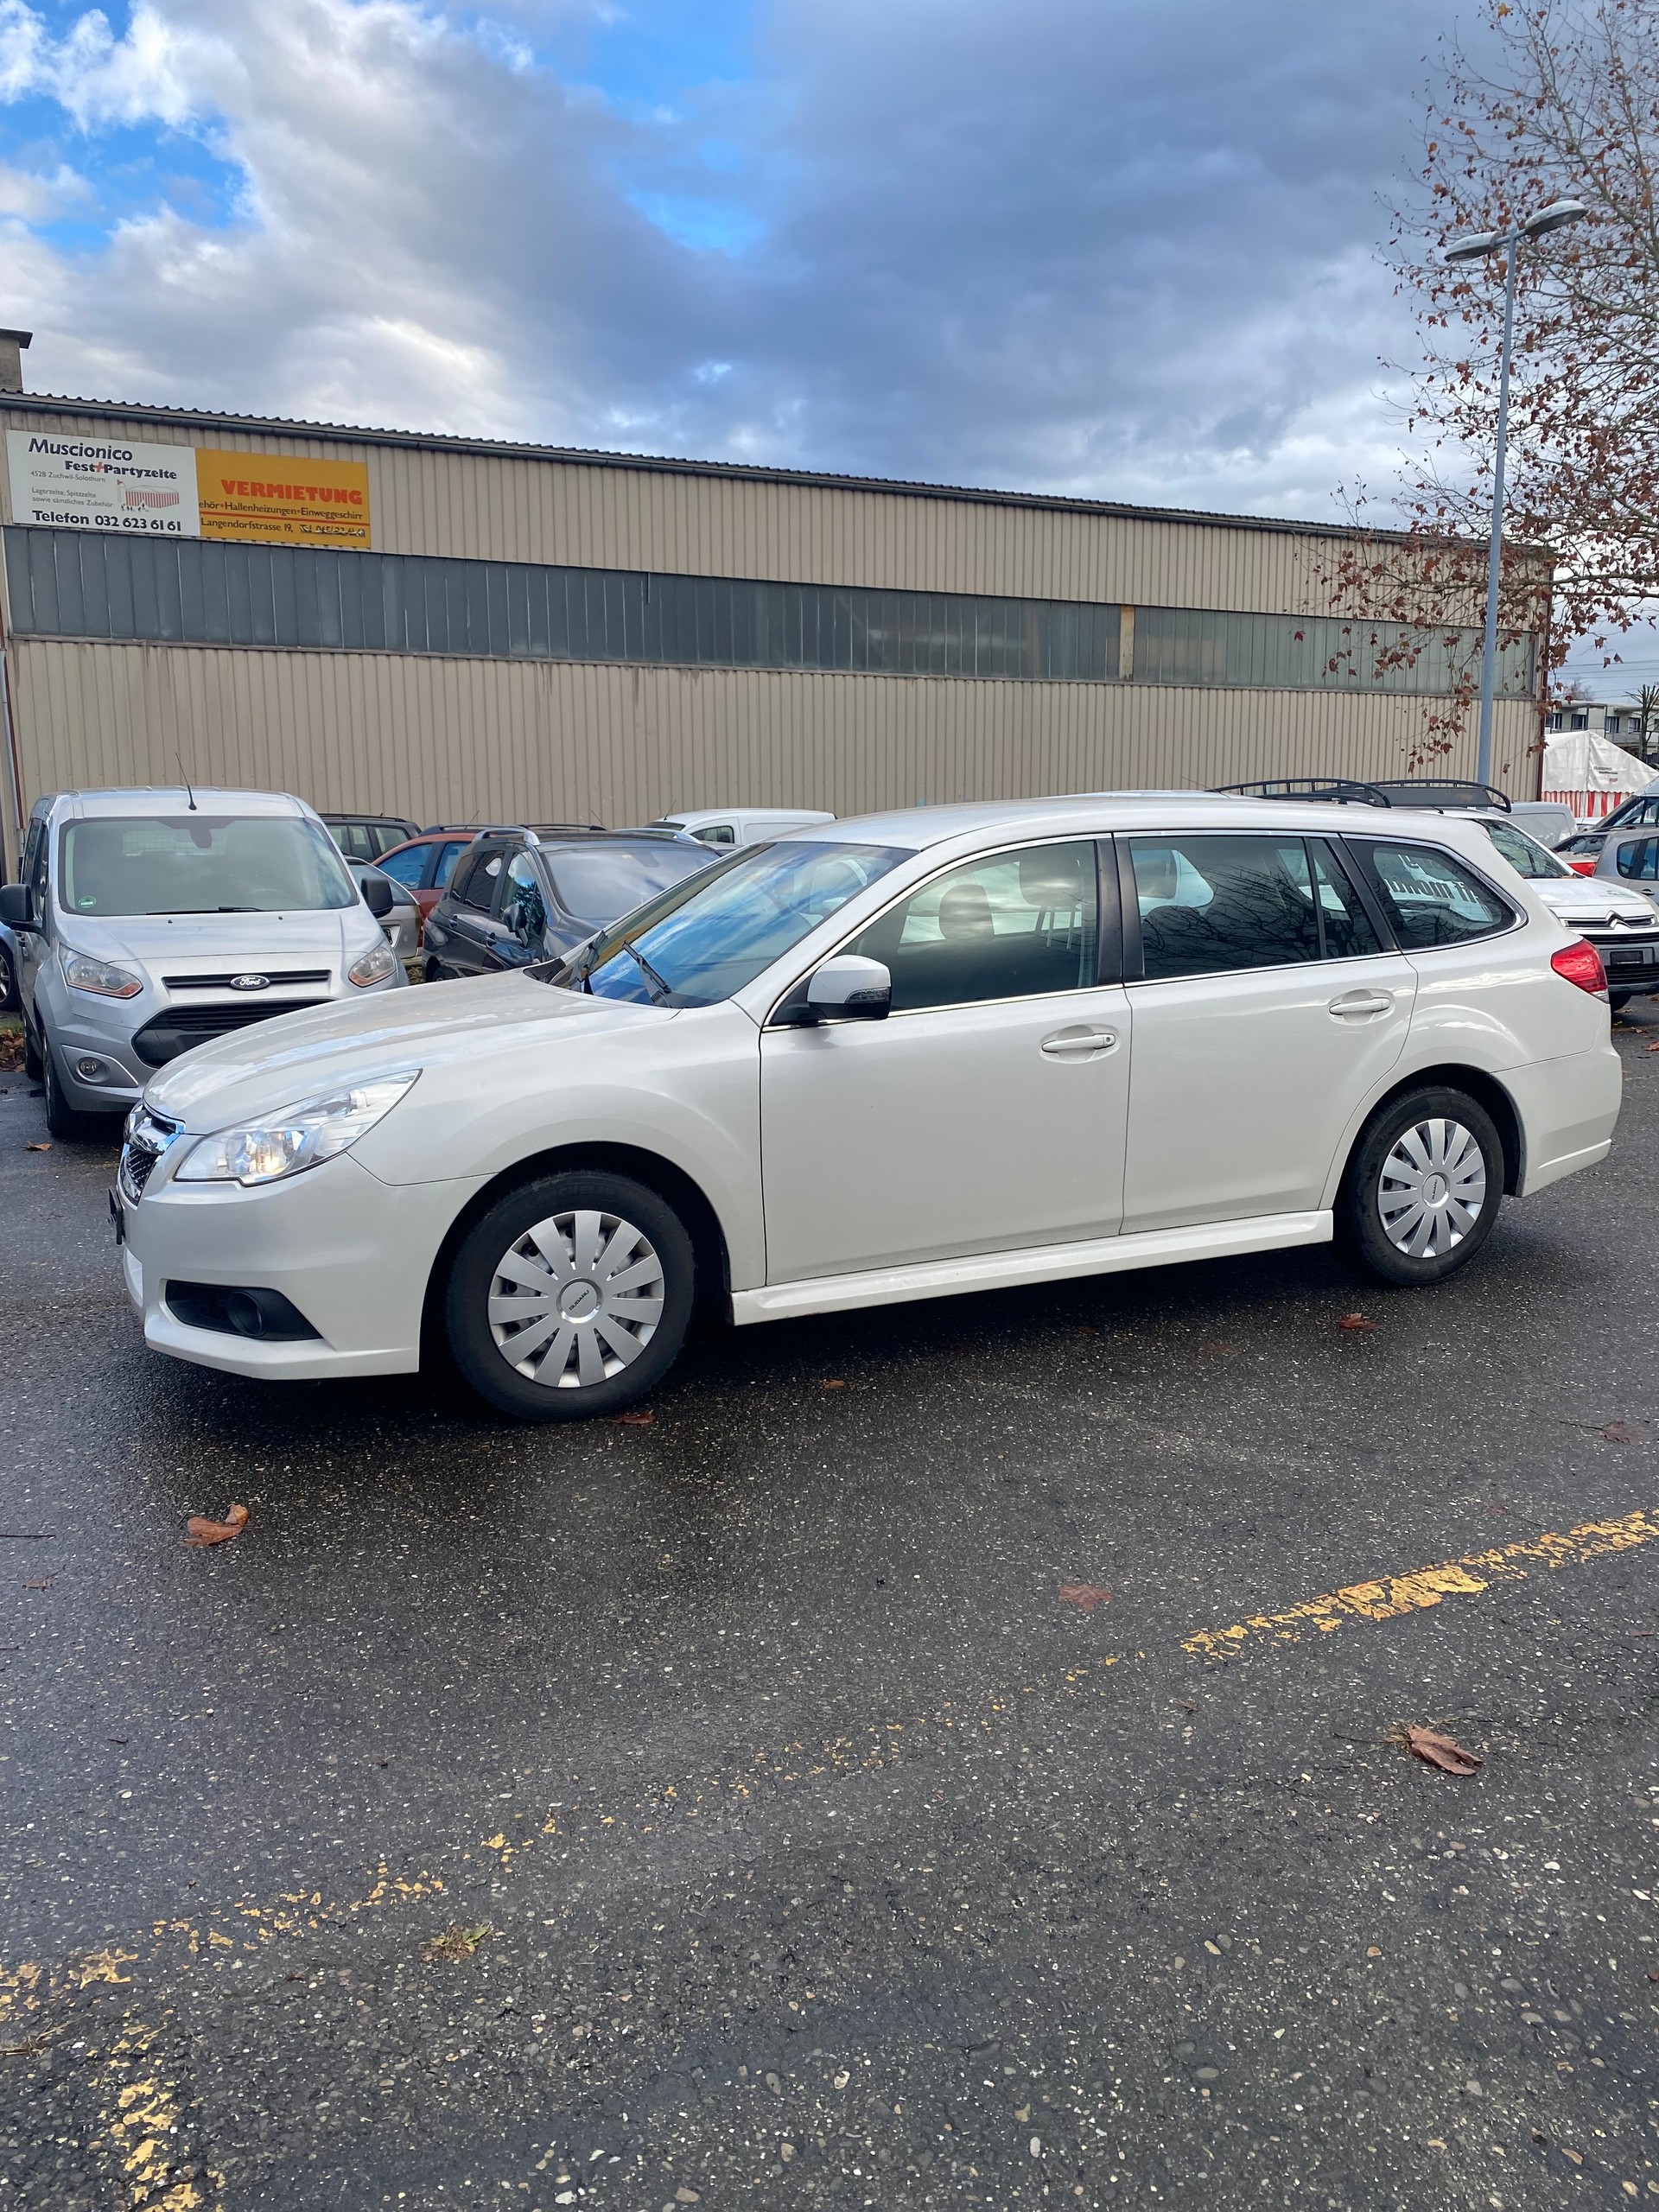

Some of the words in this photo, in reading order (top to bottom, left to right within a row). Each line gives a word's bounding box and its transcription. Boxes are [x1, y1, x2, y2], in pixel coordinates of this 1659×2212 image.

[29, 438, 133, 461] Muscionico
[48, 472, 105, 483] Zuchwil-Solothurn
[67, 490, 96, 499] Spitzzelte
[220, 480, 363, 505] VERMIETUNG
[53, 497, 85, 505] sämtliches
[86, 499, 113, 508] Zubehör
[32, 510, 90, 524] Telefon
[95, 515, 119, 527] 032
[122, 518, 147, 529] 623
[150, 519, 163, 530] 61
[167, 521, 181, 531] 61
[201, 518, 281, 531] Langendorfstrasse
[239, 976, 261, 986] Ford
[569, 1289, 589, 1311] SUBARU
